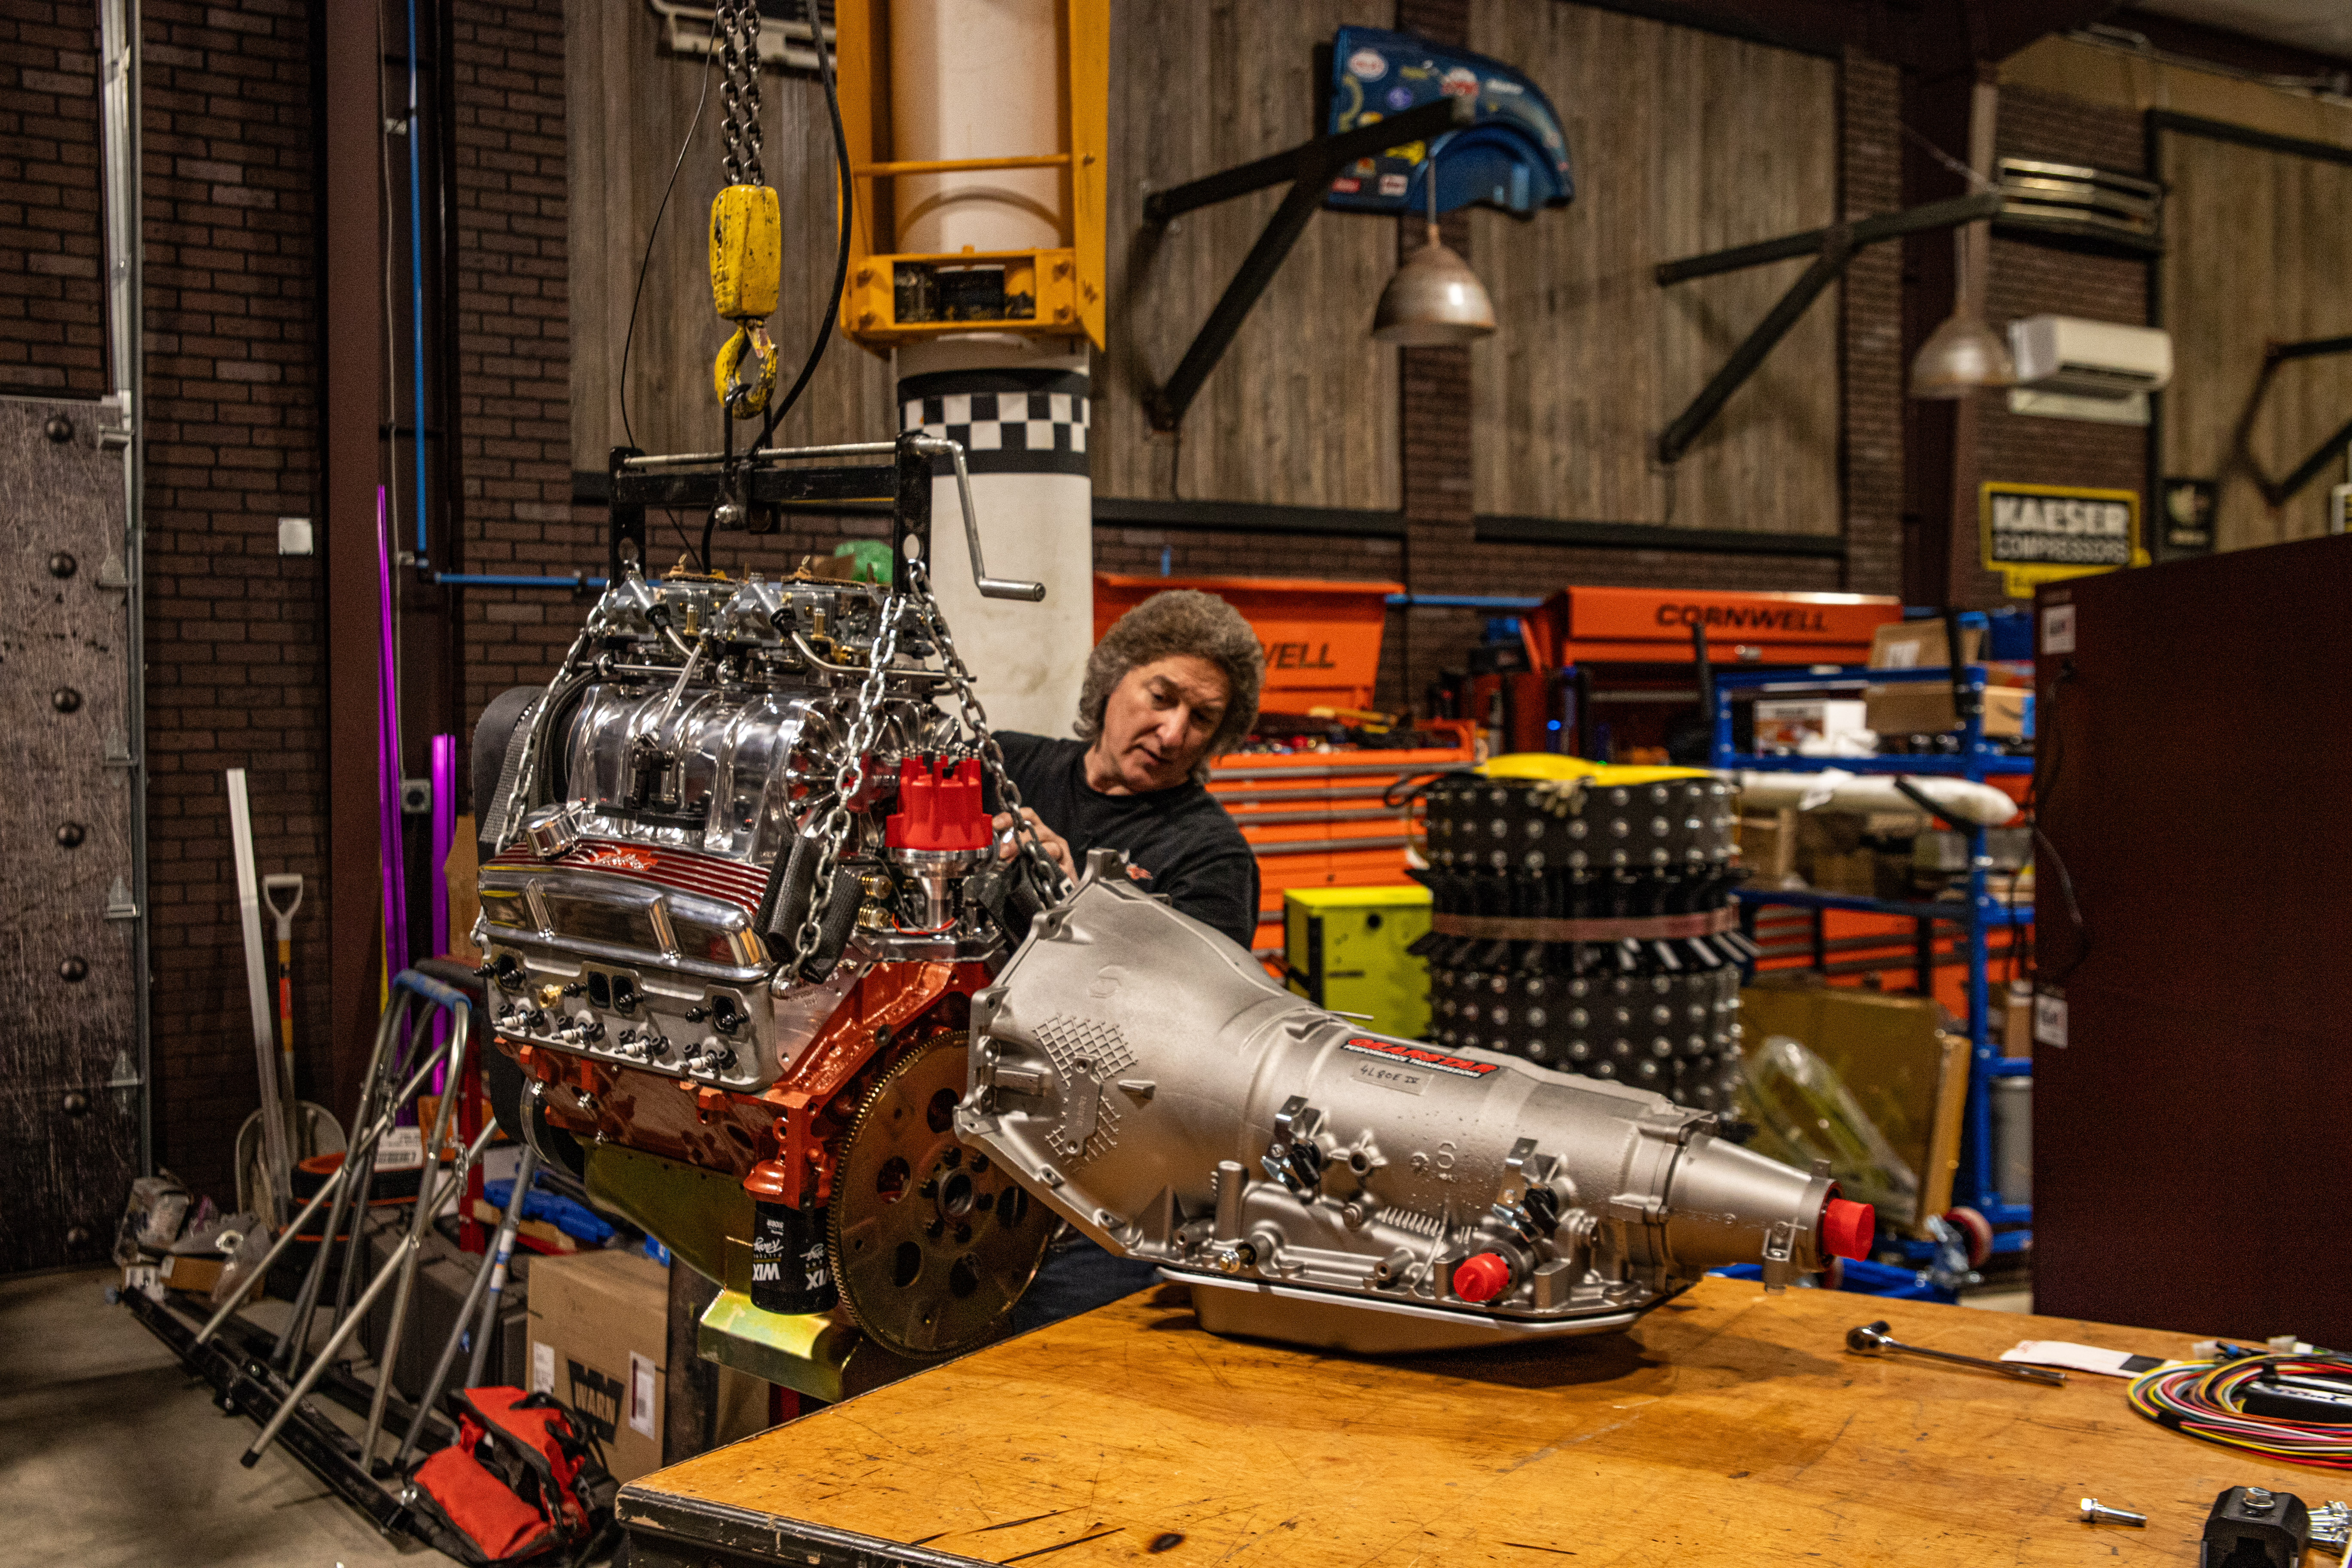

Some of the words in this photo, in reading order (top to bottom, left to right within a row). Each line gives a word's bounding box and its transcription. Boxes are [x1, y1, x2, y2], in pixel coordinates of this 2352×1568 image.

[1993, 495, 2129, 535] KAESER
[1655, 603, 1829, 632] CORNWELL
[752, 1263, 780, 1281] WIX
